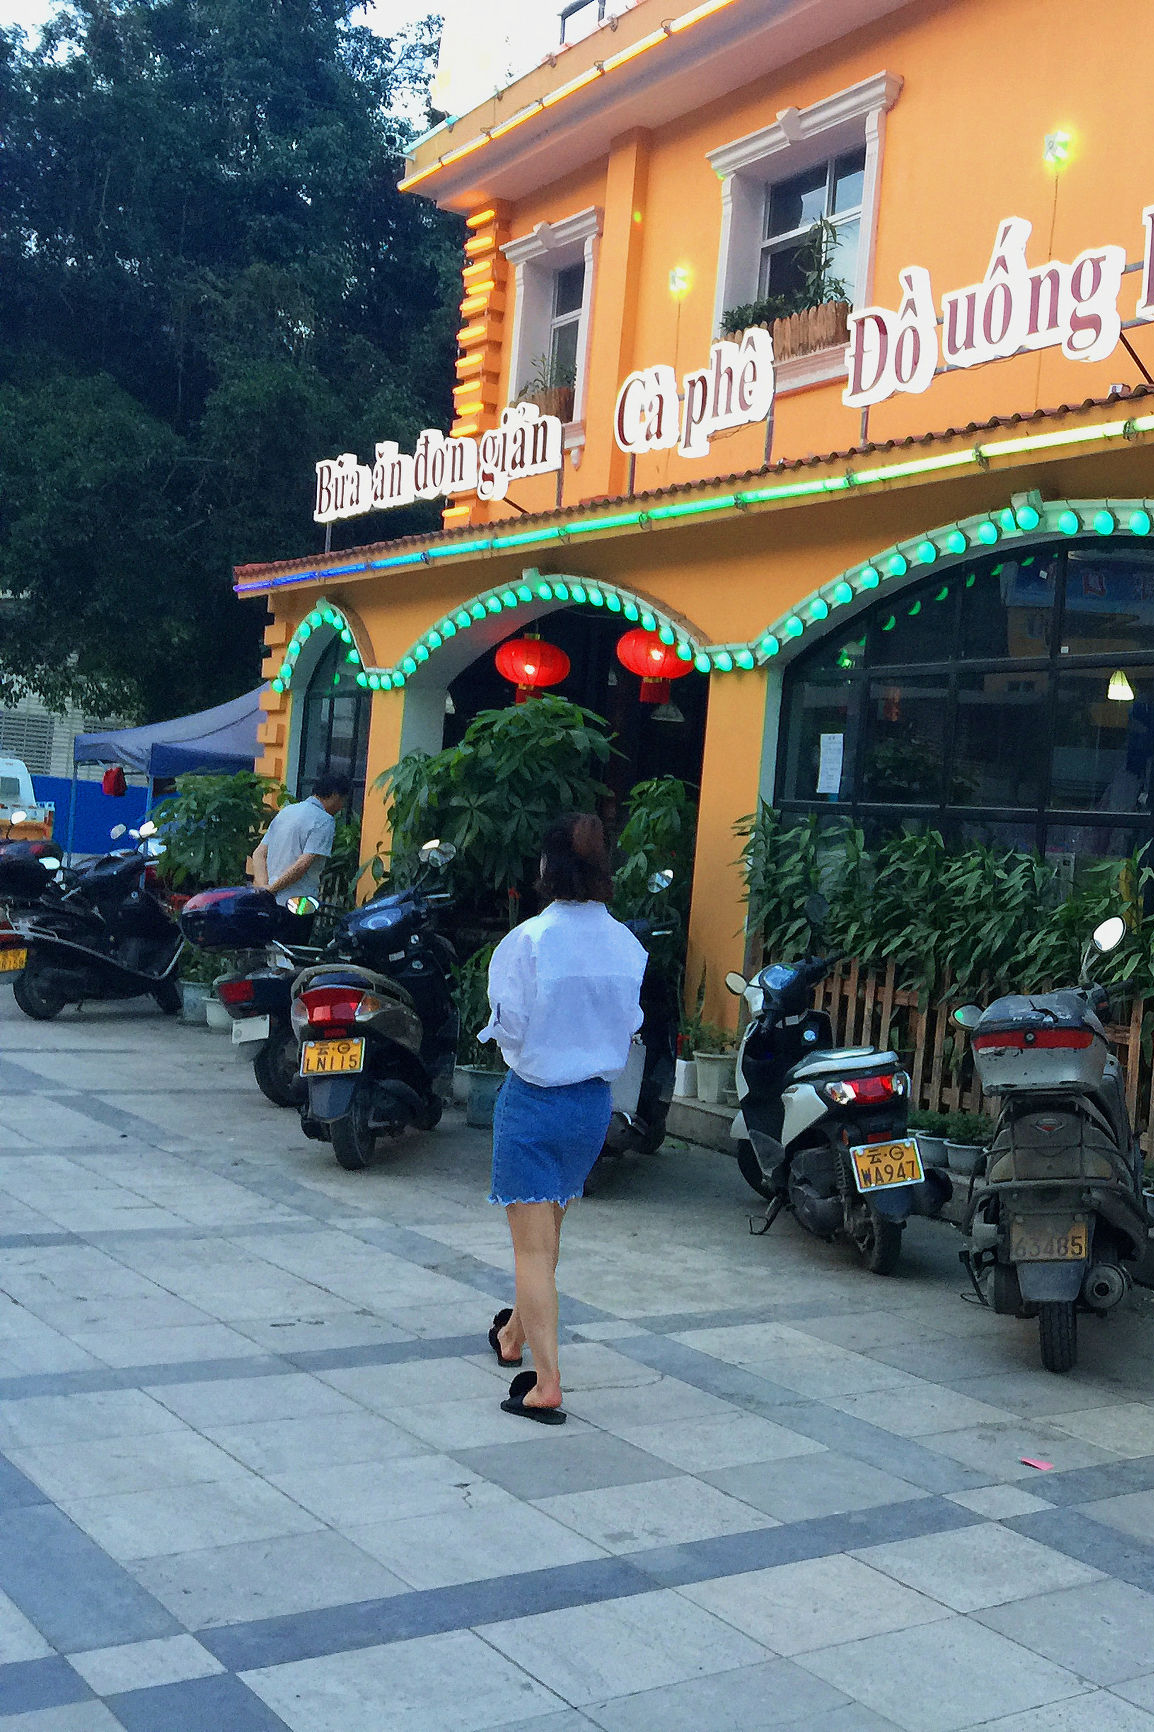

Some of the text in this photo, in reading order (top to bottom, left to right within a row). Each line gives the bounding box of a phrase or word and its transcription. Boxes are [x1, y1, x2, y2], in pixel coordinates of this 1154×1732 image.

[849, 274, 921, 397] Đồ
[946, 224, 1107, 354] uống
[617, 335, 757, 449] Cà phê
[318, 406, 548, 515] Bữa ăn đơn giản
[306, 1054, 357, 1072] LN115
[860, 1160, 915, 1185] WA947
